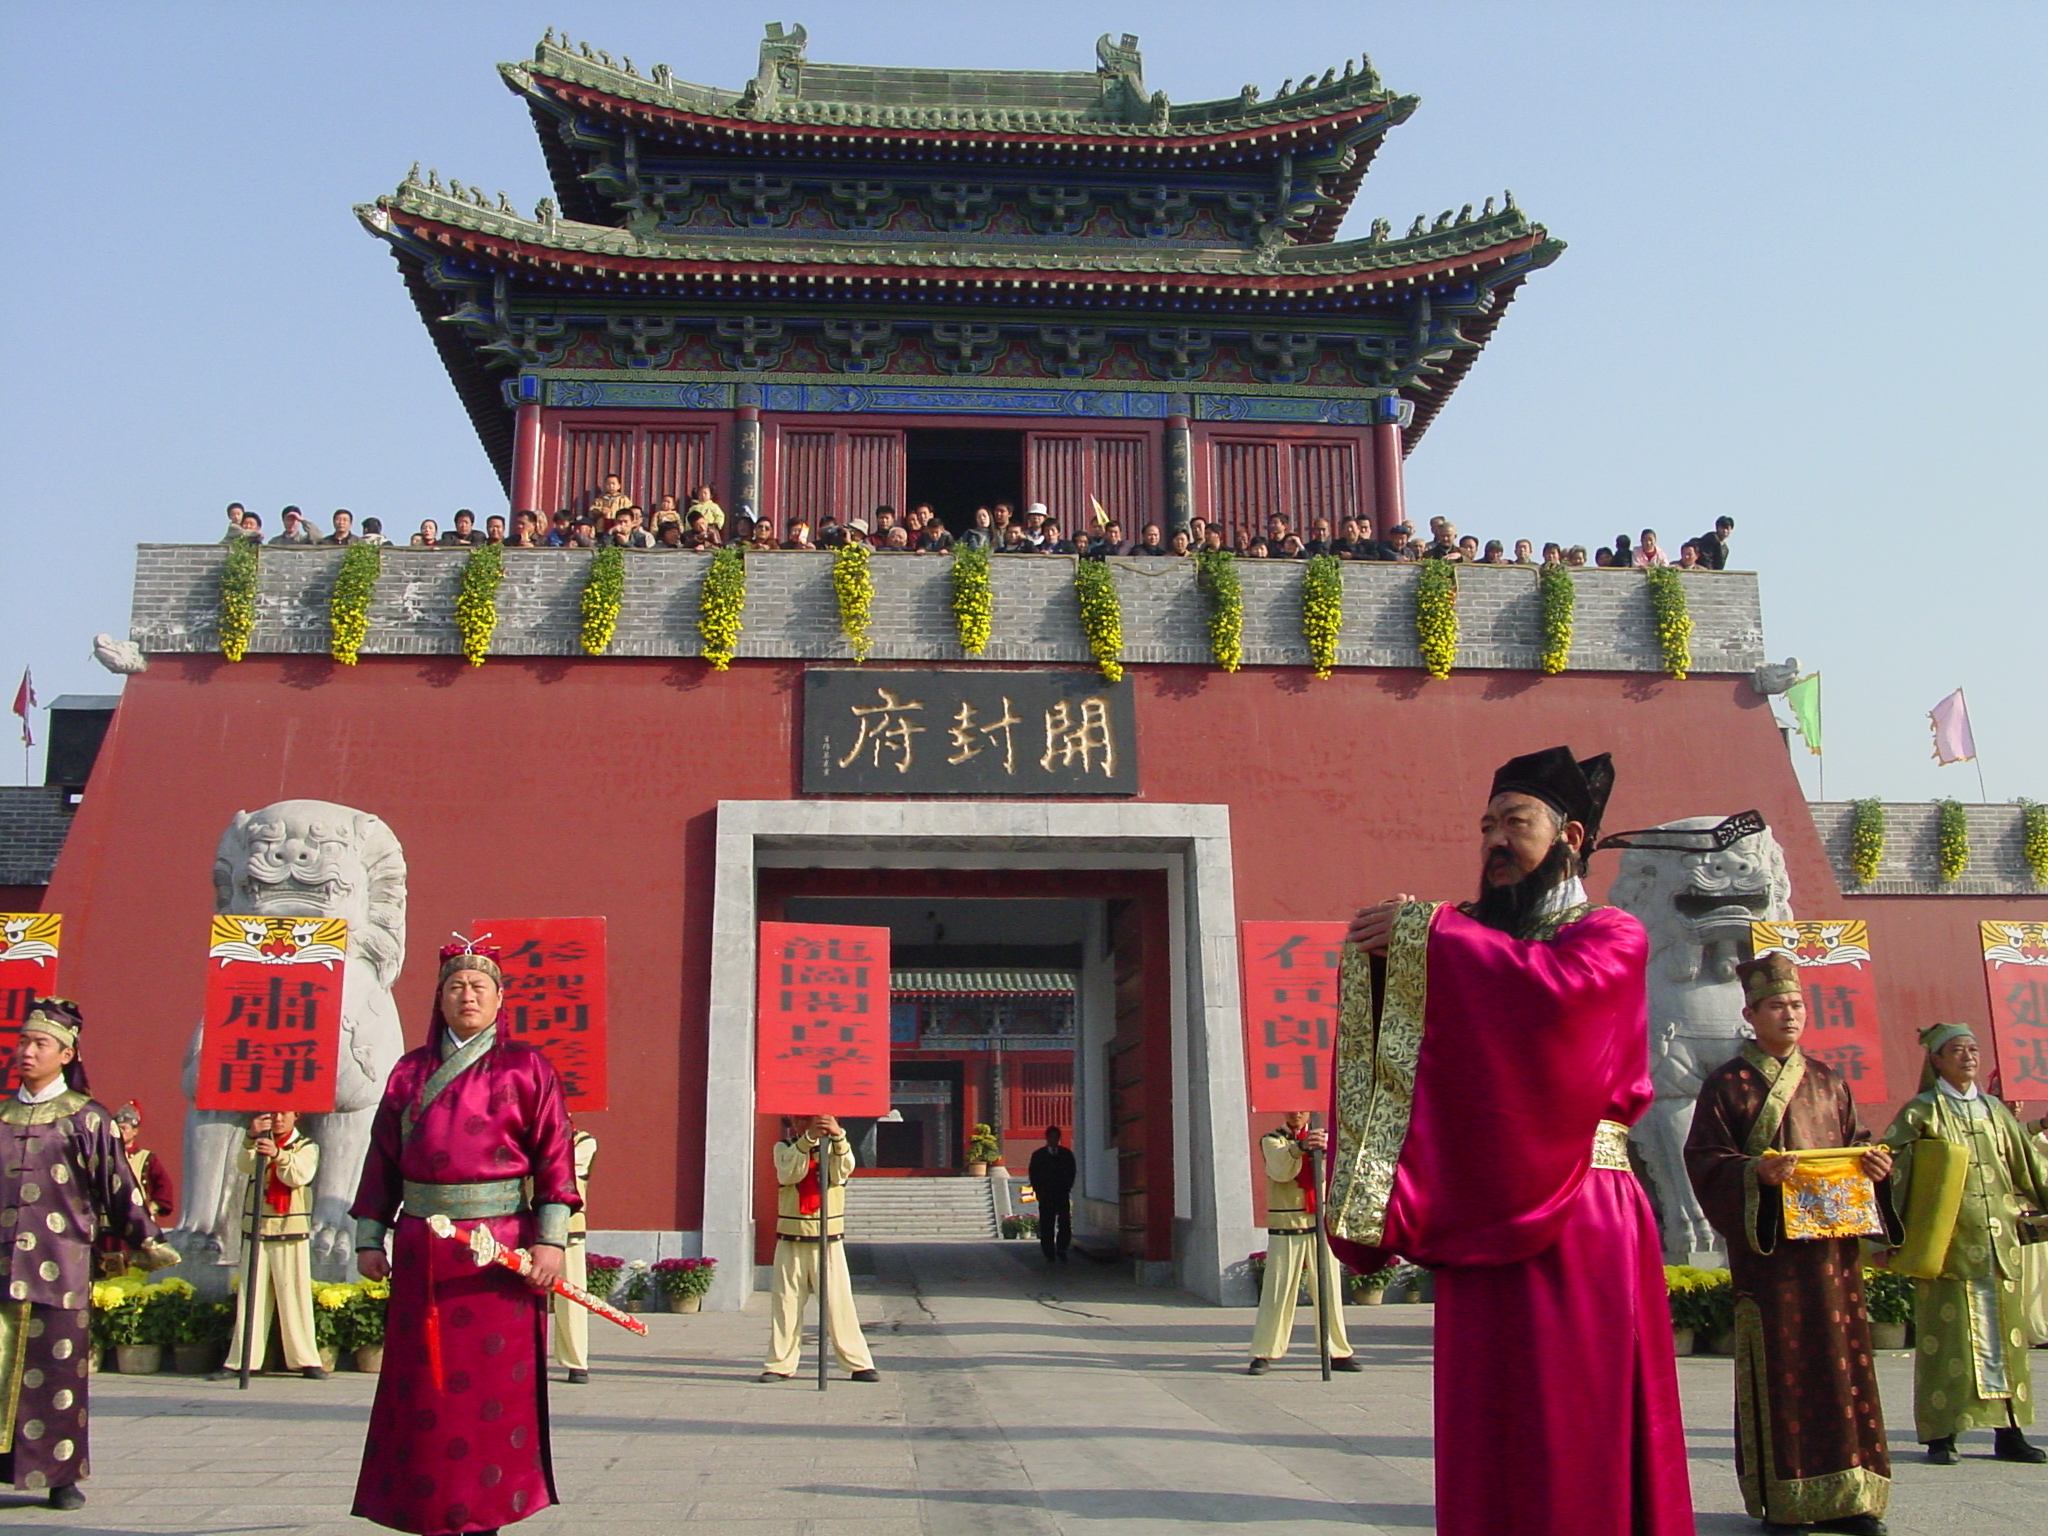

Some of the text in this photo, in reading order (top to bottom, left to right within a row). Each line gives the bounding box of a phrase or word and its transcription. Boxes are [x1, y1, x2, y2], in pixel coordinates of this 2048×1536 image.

[838, 687, 1115, 778] 開封府
[218, 976, 329, 1096] 肅靜
[775, 936, 875, 1096] 龍圖閣直學士
